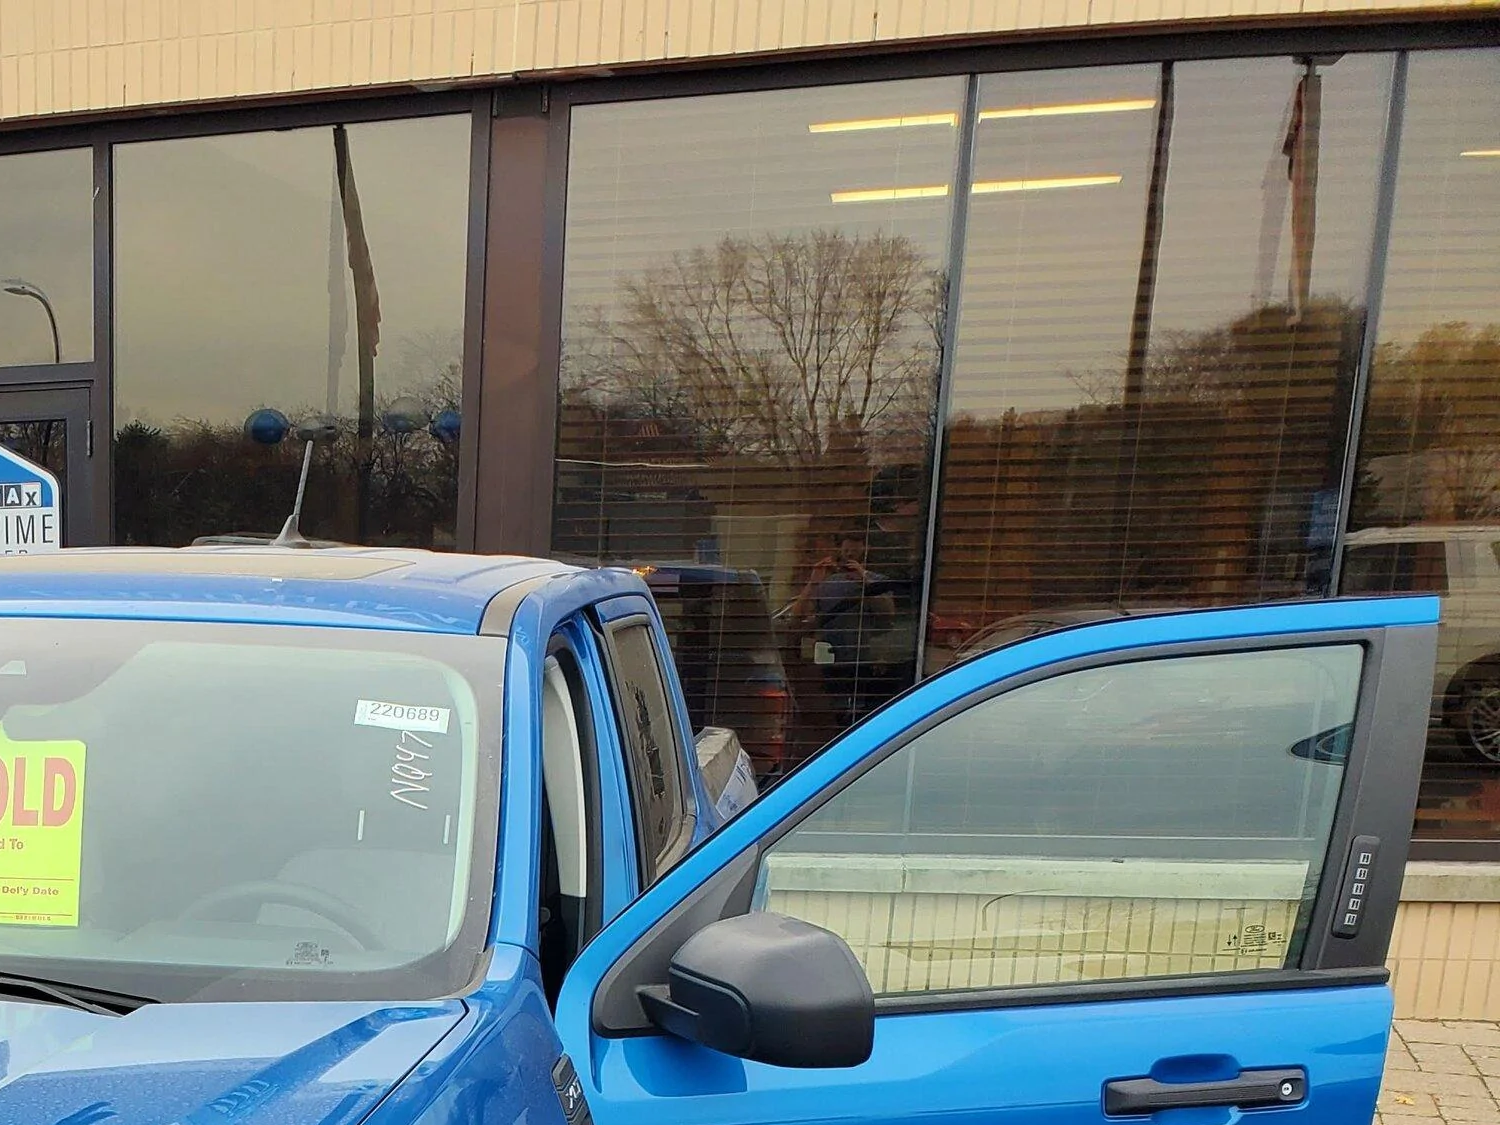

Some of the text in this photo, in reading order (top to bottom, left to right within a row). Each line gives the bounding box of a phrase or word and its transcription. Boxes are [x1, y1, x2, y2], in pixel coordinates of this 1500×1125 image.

[370, 702, 440, 722] 220689
[9, 838, 24, 850] To
[32, 886, 59, 896] Date
